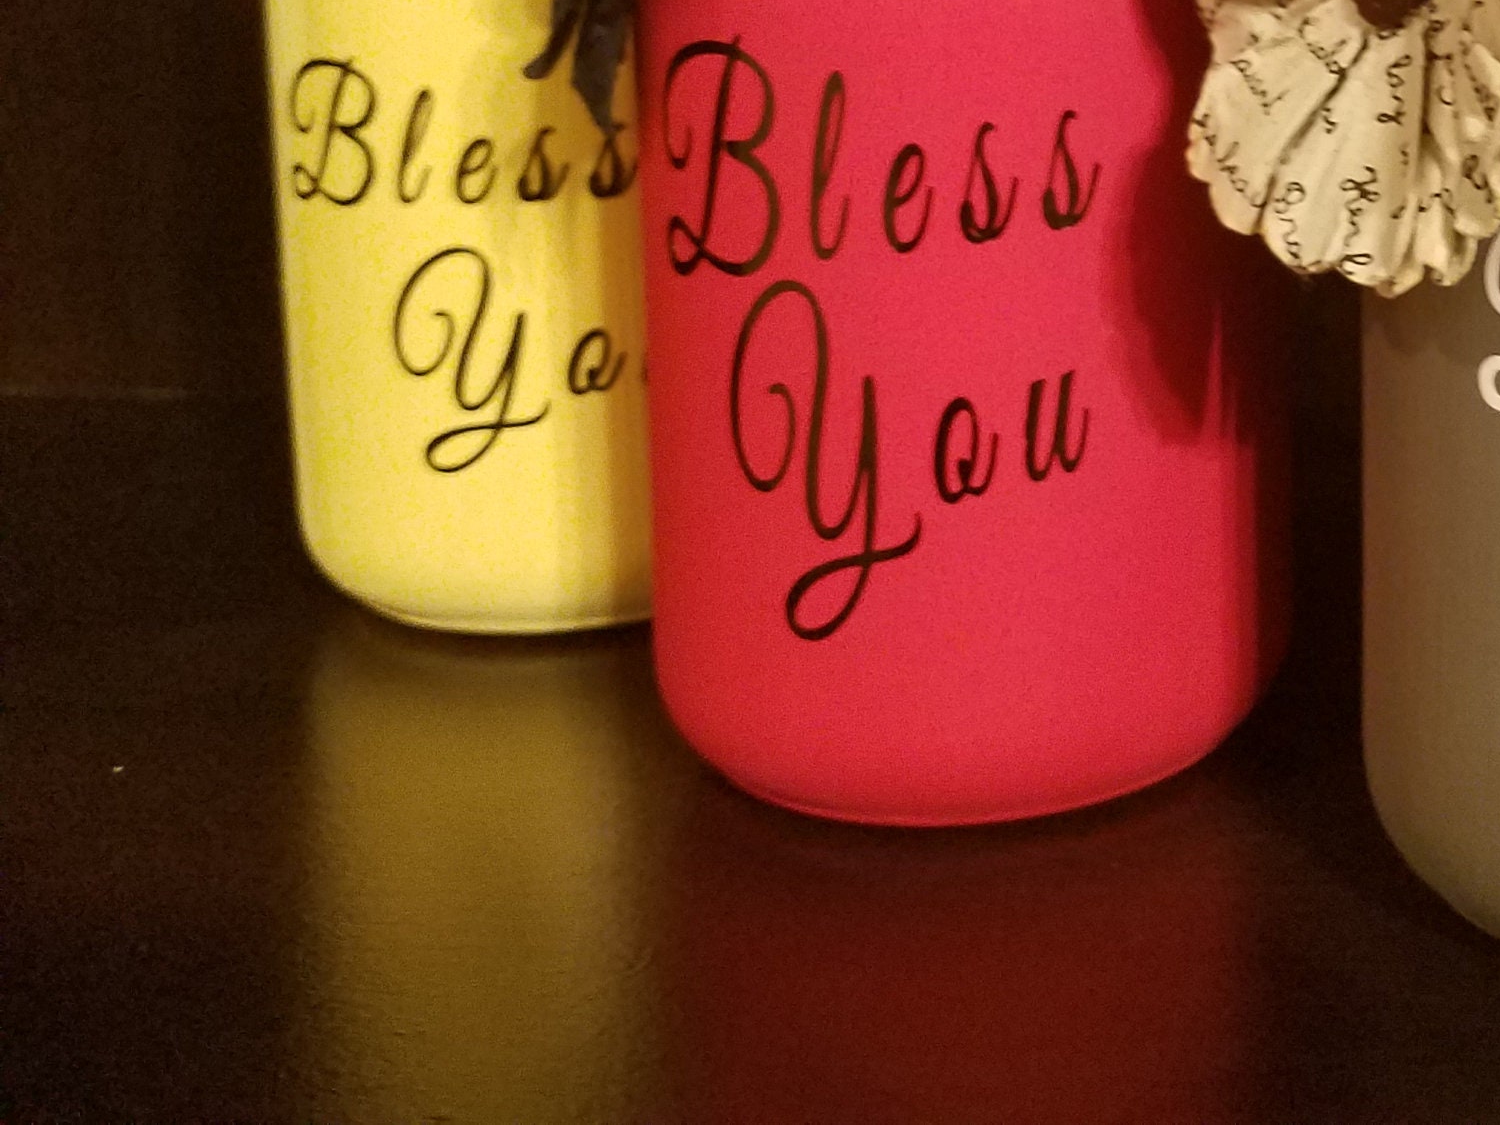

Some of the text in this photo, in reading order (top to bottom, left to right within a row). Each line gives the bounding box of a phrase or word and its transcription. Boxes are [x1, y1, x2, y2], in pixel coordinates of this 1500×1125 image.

[290, 58, 638, 204] Bless
[664, 35, 1102, 275] Bless
[394, 247, 648, 473] Yo
[731, 279, 1089, 641] You
